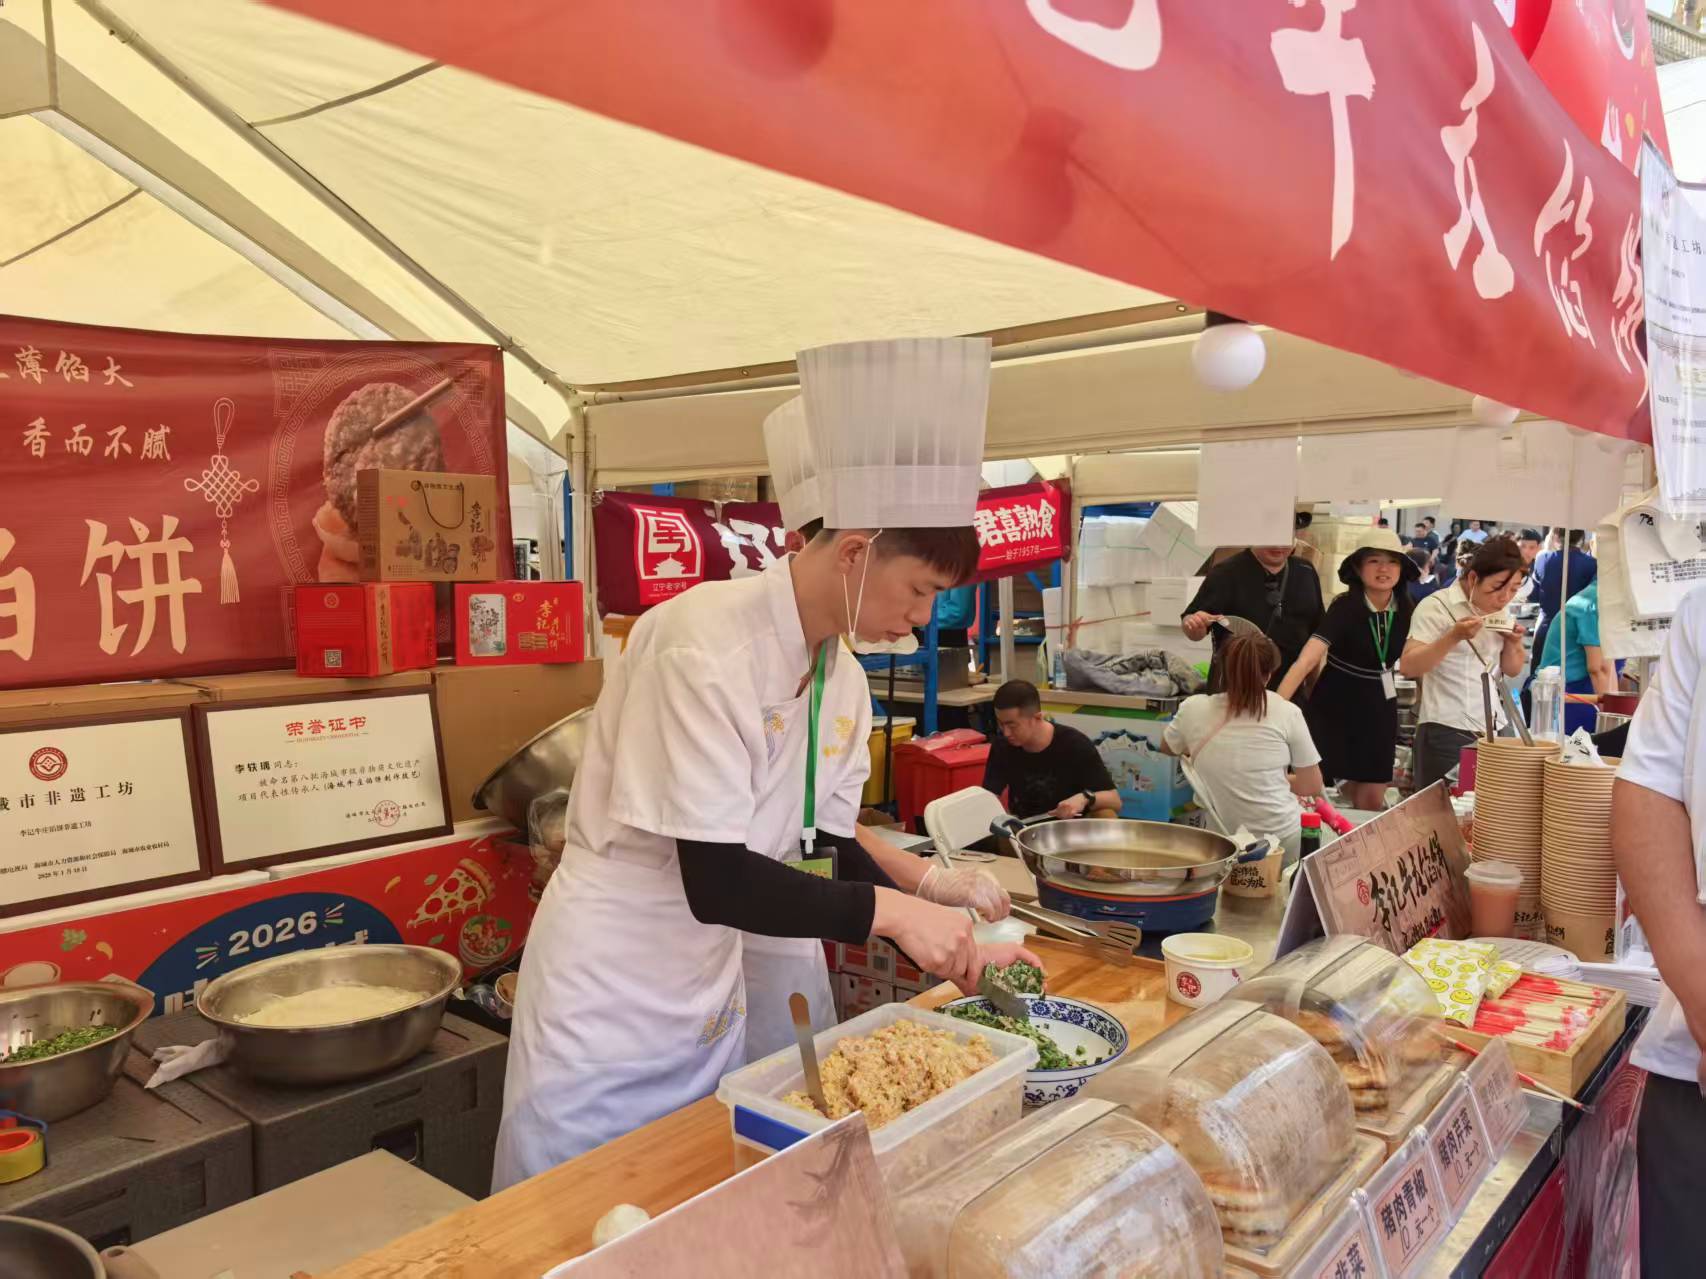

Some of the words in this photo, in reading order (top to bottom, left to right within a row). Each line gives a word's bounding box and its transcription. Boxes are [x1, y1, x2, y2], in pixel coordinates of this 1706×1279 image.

[1025, 0, 1648, 408] 牛庄馅饼
[0, 346, 134, 388] 薄馅大
[22, 416, 173, 462] 香而不腻
[536, 599, 553, 630] 李记
[285, 716, 367, 737] 荣誉证书
[1369, 829, 1452, 932] 李记牛庄馅饼
[228, 910, 318, 957] 2026
[1439, 1106, 1472, 1170] 猪肉芹菜
[1381, 1168, 1428, 1240] 猪肉青椒
